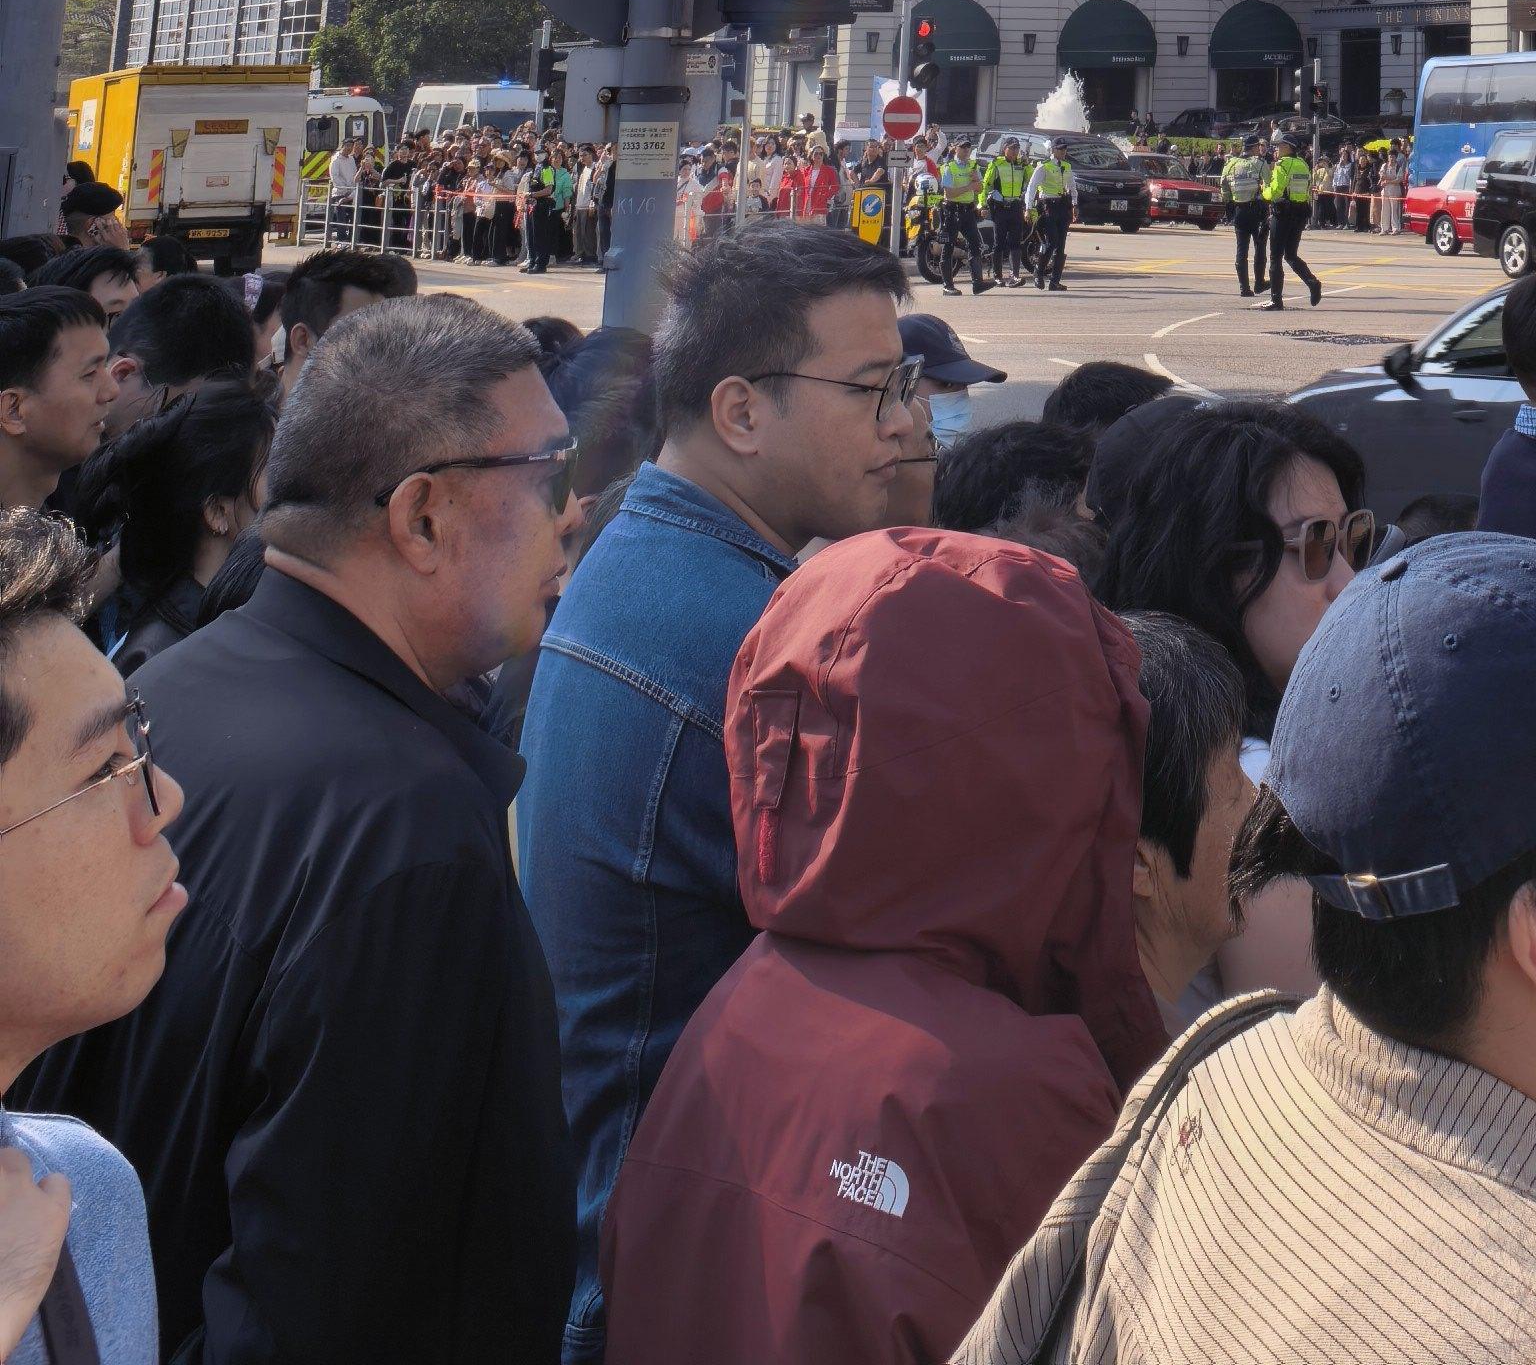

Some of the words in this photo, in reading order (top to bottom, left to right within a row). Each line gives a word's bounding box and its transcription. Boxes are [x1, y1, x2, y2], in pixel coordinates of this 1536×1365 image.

[1376, 10, 1403, 24] THE
[858, 1149, 888, 1175] THE
[829, 1159, 884, 1193] NORTH
[836, 1179, 878, 1207] FACE
